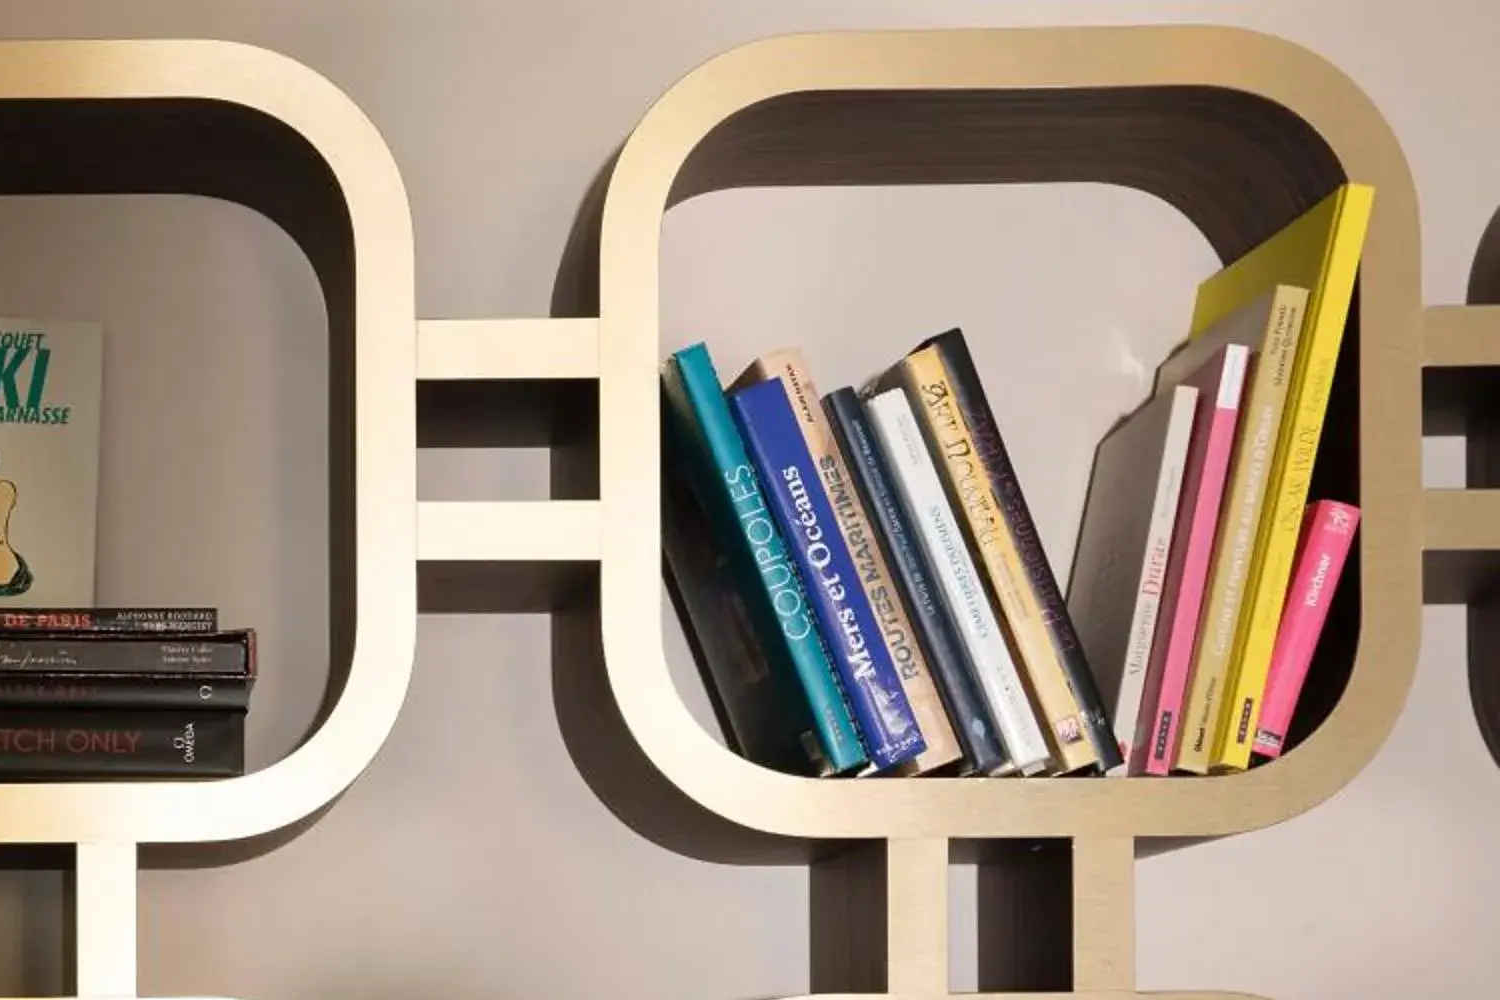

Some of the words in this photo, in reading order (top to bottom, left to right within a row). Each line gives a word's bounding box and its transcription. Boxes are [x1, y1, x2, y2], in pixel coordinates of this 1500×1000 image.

[720, 462, 816, 643] COUPOLES
[773, 463, 834, 570] Océans
[816, 453, 882, 583] MARITIMES
[818, 571, 847, 604] et
[1303, 552, 1332, 607] Kirchner
[4, 614, 33, 627] DE
[36, 613, 91, 628] PARIS
[832, 607, 878, 681] Mers
[867, 584, 921, 681] ROUTES
[66, 730, 143, 753] ONLY
